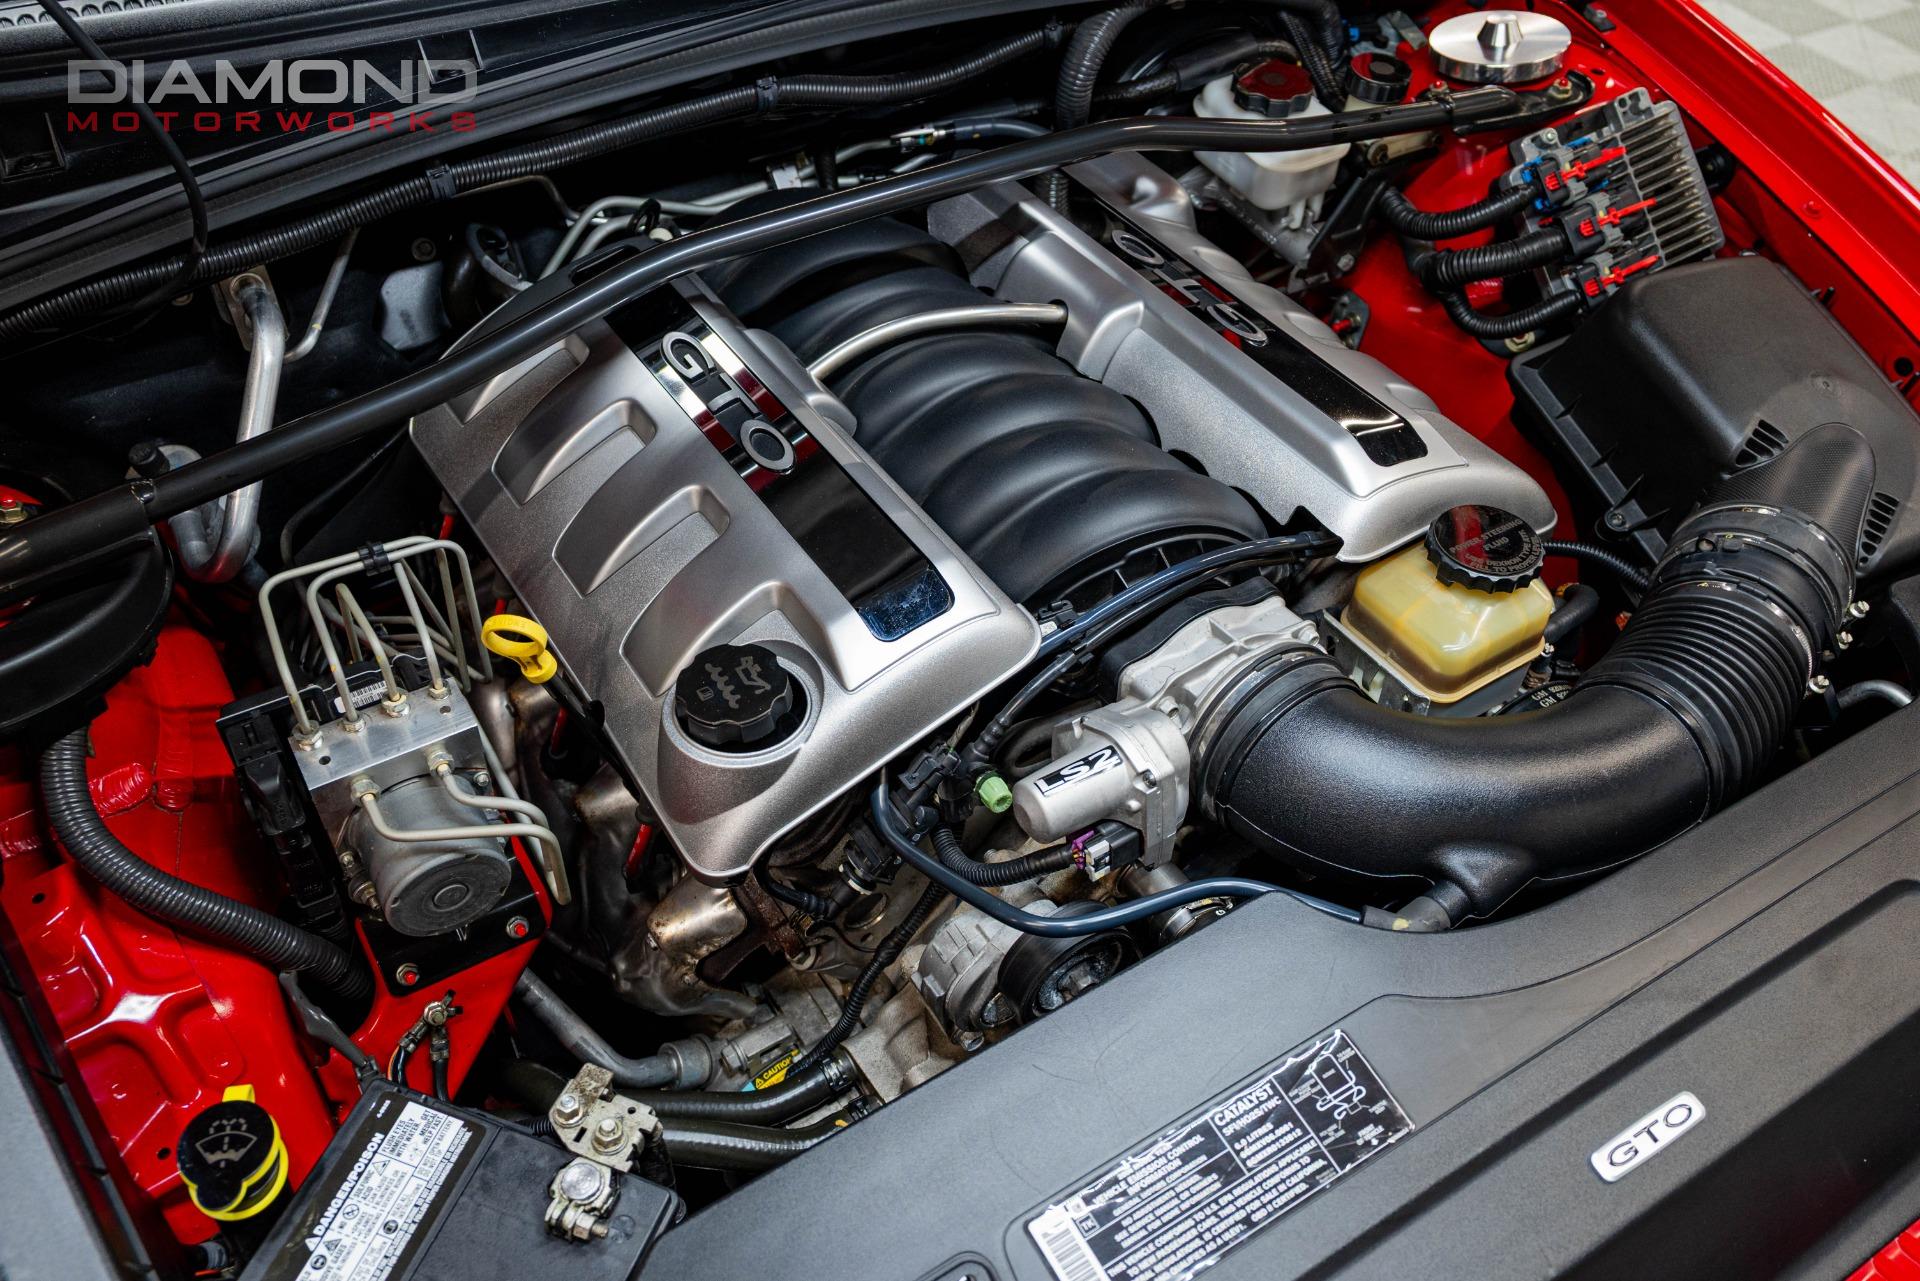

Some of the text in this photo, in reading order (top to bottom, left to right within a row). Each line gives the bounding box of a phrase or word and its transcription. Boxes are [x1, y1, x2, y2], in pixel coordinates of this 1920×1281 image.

[1111, 229, 1258, 347] GTO
[660, 331, 797, 474] GTO
[1449, 519, 1523, 553] POWER STEERING
[1483, 536, 1510, 551] FLUID
[1034, 748, 1120, 796] LS2
[419, 1112, 437, 1136] MEDICAL
[421, 1110, 430, 1119] GET
[1213, 1082, 1275, 1127] CATALYST
[382, 1120, 405, 1152] FLUSH EYES
[388, 1118, 414, 1154] IMMEDIATELY
[1607, 1103, 1693, 1167] GTO
[312, 1132, 384, 1236] DANGER/POISON
[1093, 1131, 1204, 1206] VEHICLE EMISSION CONTROL
[1126, 1157, 1181, 1195] INFORMATION
[1234, 1185, 1264, 1208] VEHICLE
[1261, 1161, 1301, 1190] CONFORMS
[1299, 1155, 1311, 1166] TO
[1124, 1242, 1156, 1266] VEHICLE
[1192, 1210, 1206, 1222] TO
[1217, 1192, 1234, 1206] EPA
[1232, 1163, 1279, 1197] REGULATIONS
[1276, 1139, 1317, 1168] APPLICABLE
[1245, 1199, 1262, 1213] FOR
[1260, 1188, 1279, 1204] SALE
[1277, 1183, 1287, 1193] IN
